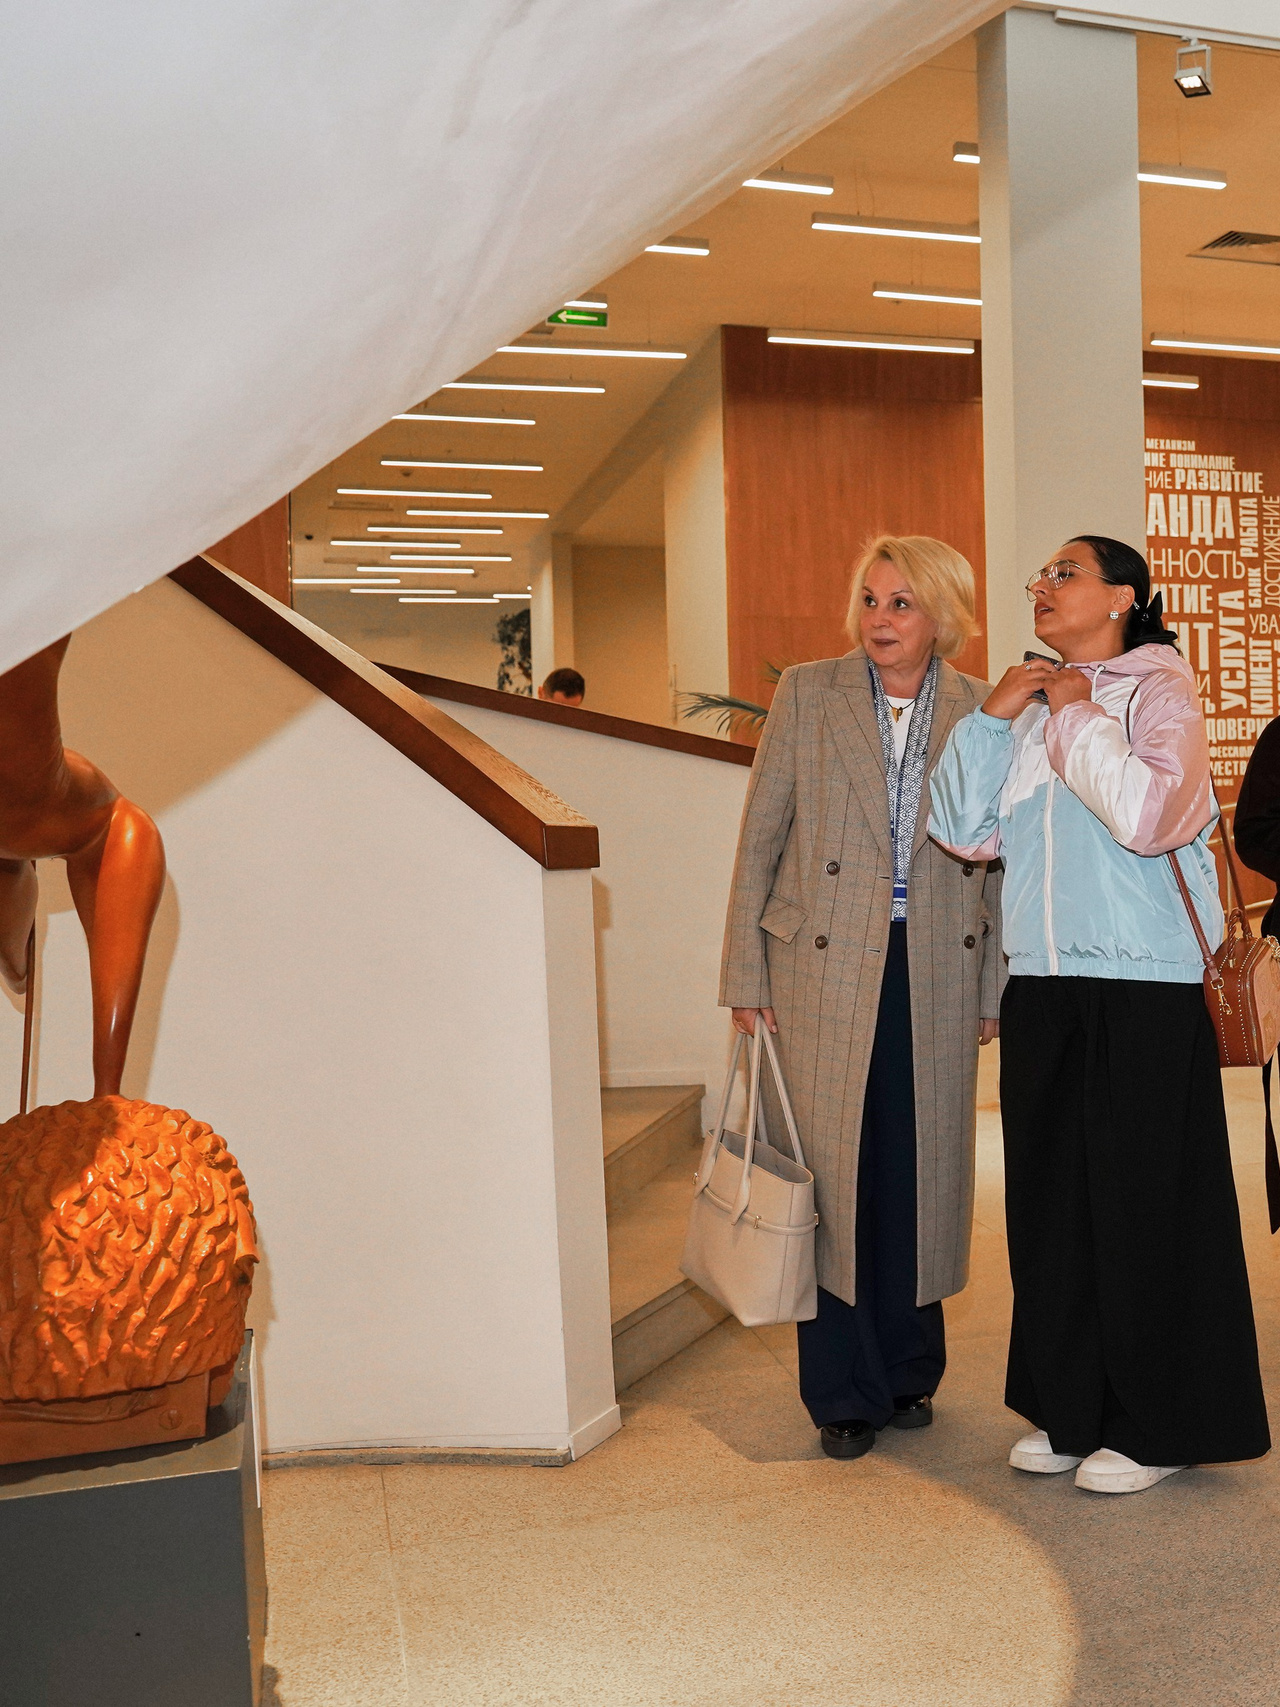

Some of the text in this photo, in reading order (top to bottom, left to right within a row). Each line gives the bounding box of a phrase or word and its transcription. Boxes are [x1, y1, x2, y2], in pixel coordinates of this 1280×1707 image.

[1146, 438, 1196, 451] МЕХАНИЗМ
[1170, 453, 1235, 470] ПОНИМАНИЕ
[1175, 468, 1263, 493] РАЗВИТИЕ
[1146, 493, 1235, 545] АНДА
[1239, 498, 1259, 557] РАБОТА
[1150, 548, 1245, 579] ННОСТЬ
[1248, 567, 1262, 608] БАНК
[1218, 590, 1247, 711] УСЛУГА
[1249, 637, 1273, 715] КЛИЕНТ
